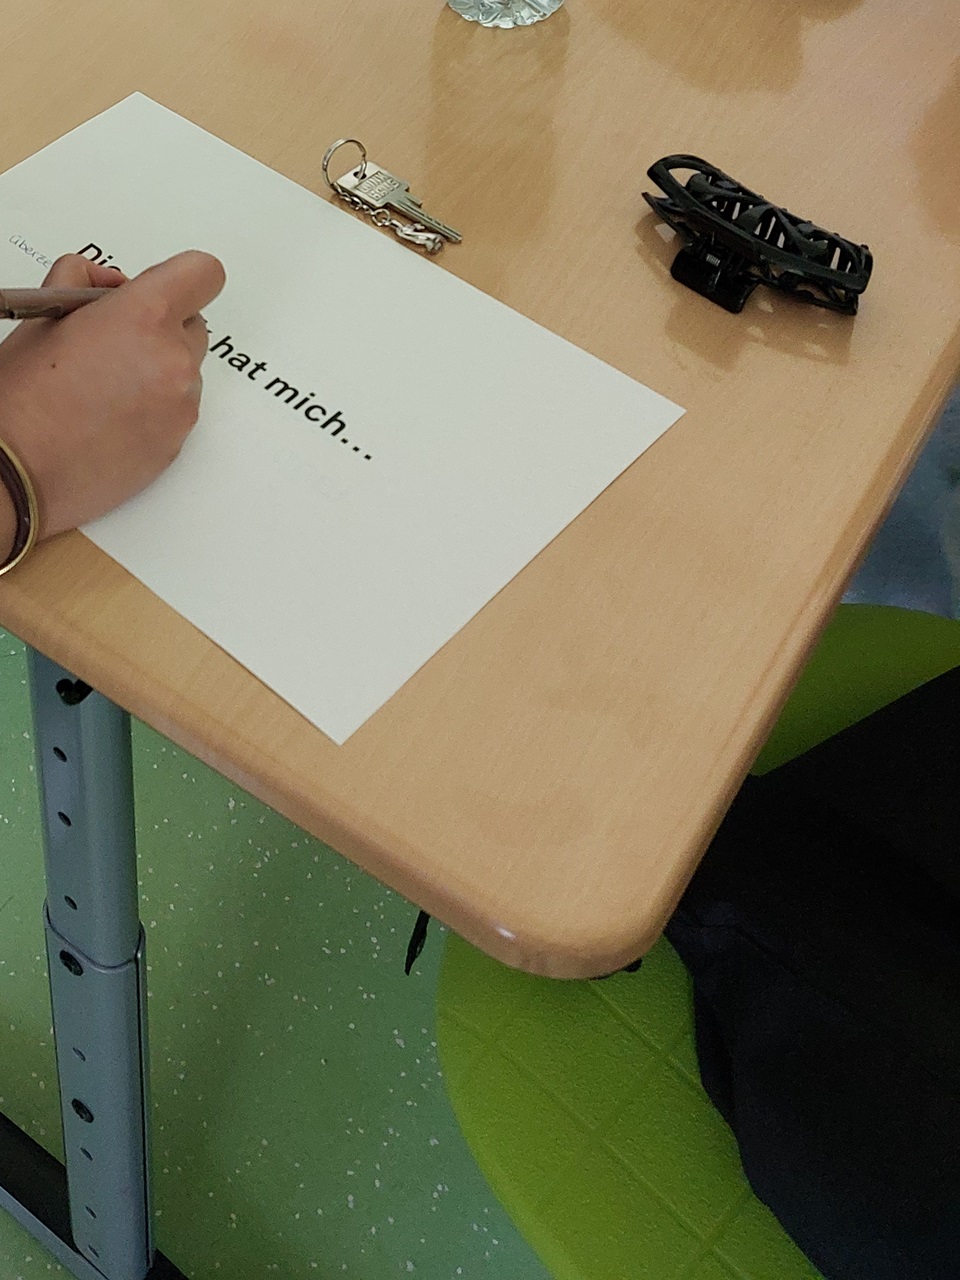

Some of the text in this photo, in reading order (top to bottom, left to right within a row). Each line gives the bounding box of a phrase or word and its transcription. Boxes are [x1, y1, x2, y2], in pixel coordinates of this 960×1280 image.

[76, 243, 372, 461] Di hat mich...
